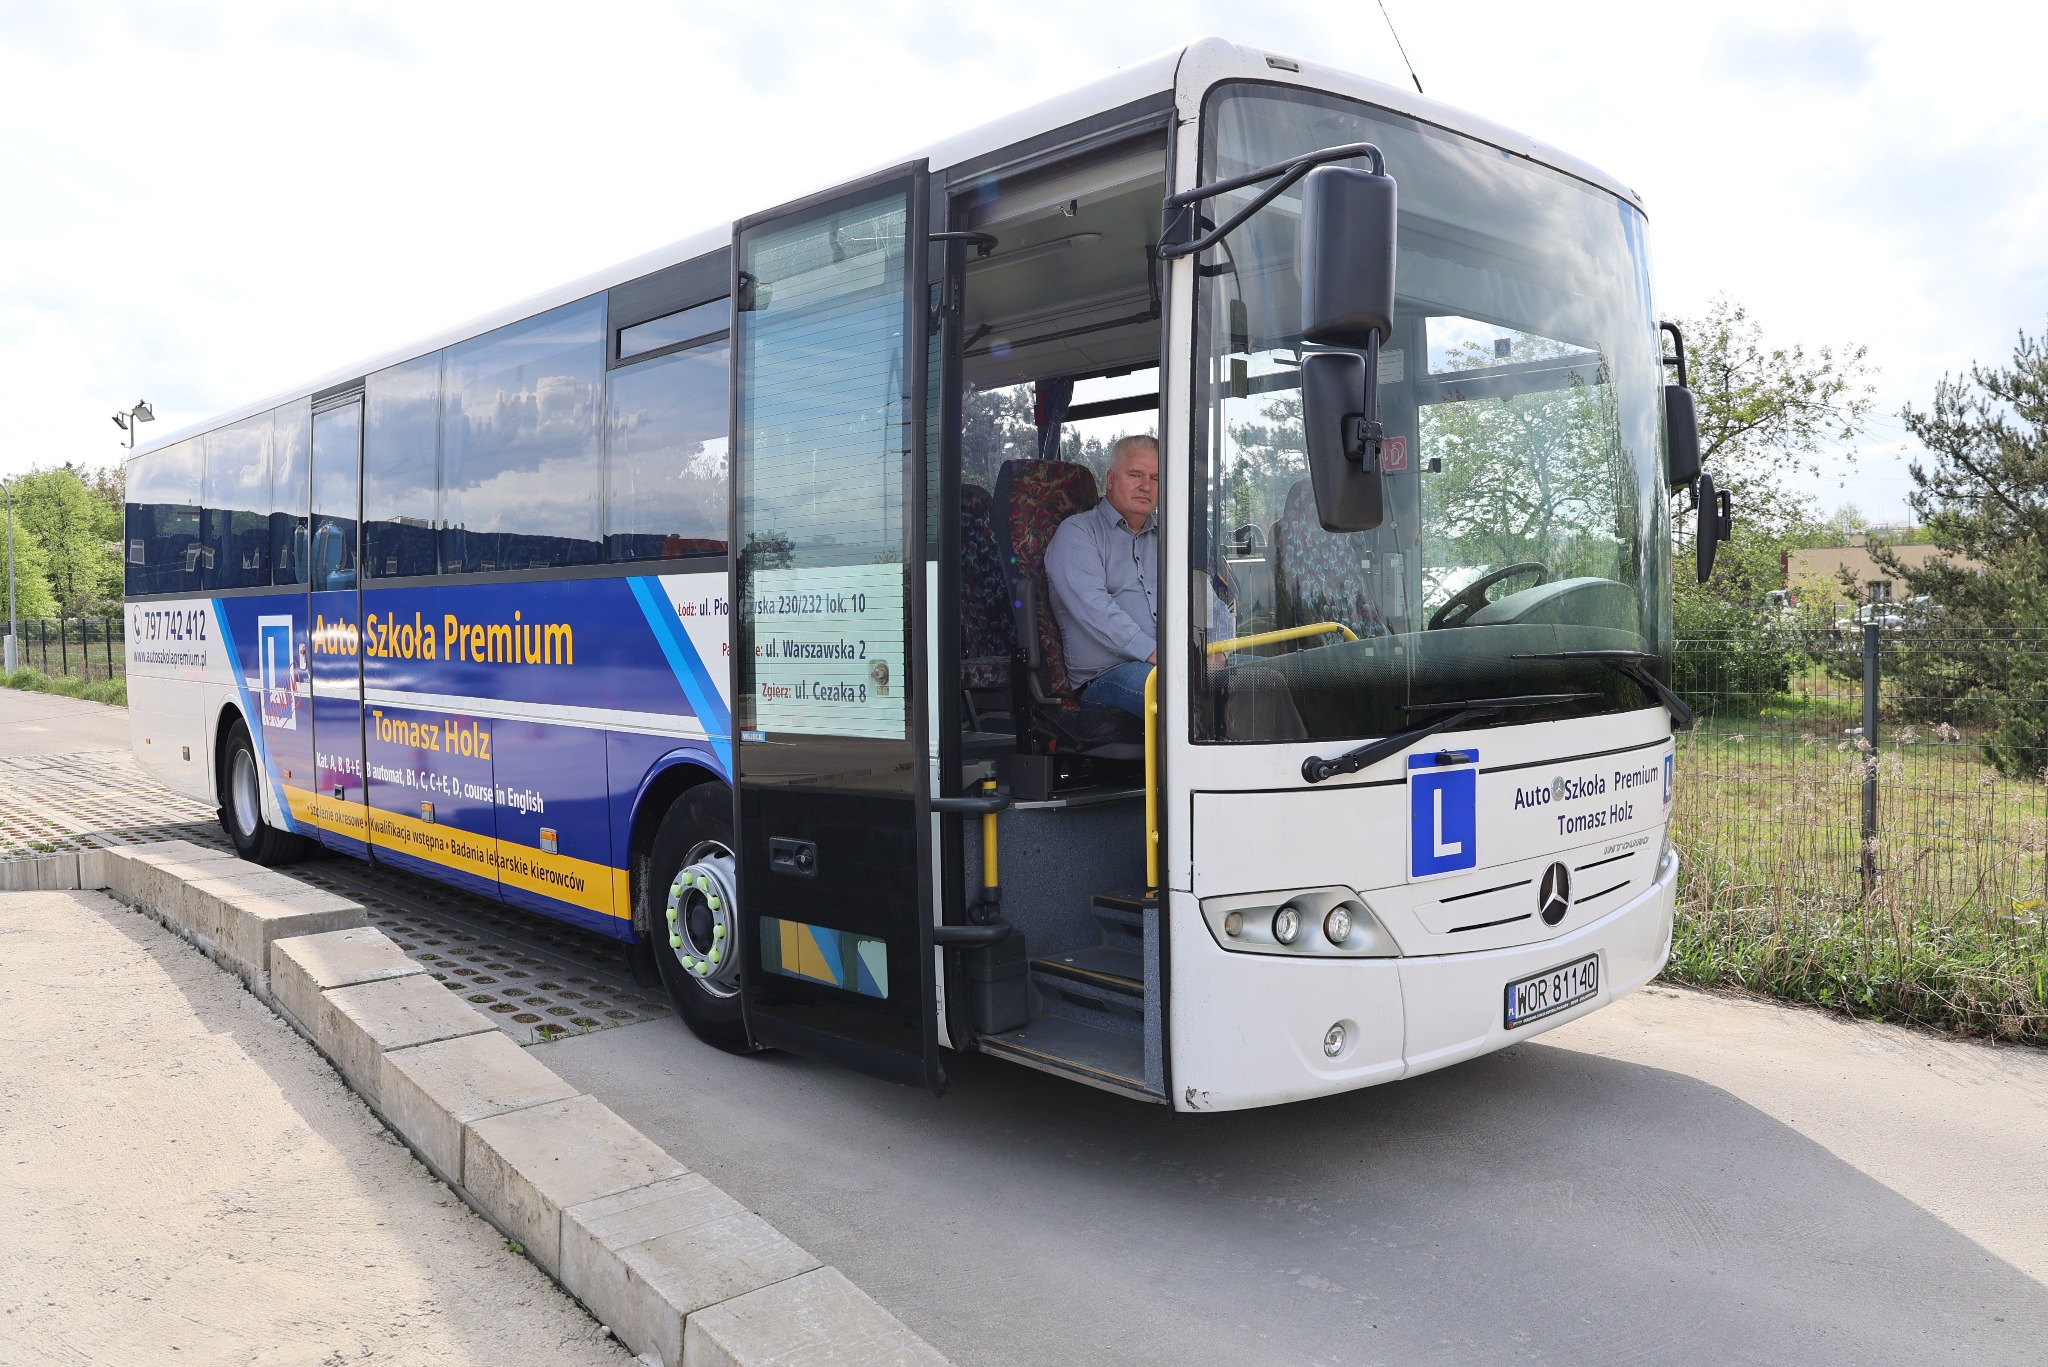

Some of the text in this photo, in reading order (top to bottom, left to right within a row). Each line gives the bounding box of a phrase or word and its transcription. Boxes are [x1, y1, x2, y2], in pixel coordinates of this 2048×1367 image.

[699, 597, 711, 616] ul.
[778, 593, 822, 616] 230/232
[825, 593, 847, 614] lok.
[851, 592, 866, 614] 10
[144, 609, 206, 641] 797 742 412
[313, 610, 574, 665] Auto Szkoła Premium
[133, 648, 207, 670] www.autoszkolapremium.pl
[765, 638, 779, 658] ul.
[782, 638, 855, 660] Warszawska
[858, 639, 866, 660] 2
[761, 680, 867, 703] Zgierz: ul. Cezaka 8
[372, 709, 491, 761] Tomasz Holz
[316, 752, 544, 815] Kat. A, B, B+E, B automat, B1, C, C+E, D, course in English
[1514, 764, 1659, 811] Auto Szkoła Premium
[1433, 788, 1462, 858] L
[1558, 810, 1607, 836] Tomasz
[1609, 800, 1633, 825] Holz
[369, 817, 411, 844] Kwalifikacja
[412, 831, 444, 852] wstępna
[450, 839, 485, 863] Badania
[486, 848, 529, 876] lekarskie
[530, 860, 585, 892] kierowców
[1517, 978, 1548, 1016] WOR
[1552, 961, 1596, 1003] 81140
[1508, 1008, 1515, 1017] PL
